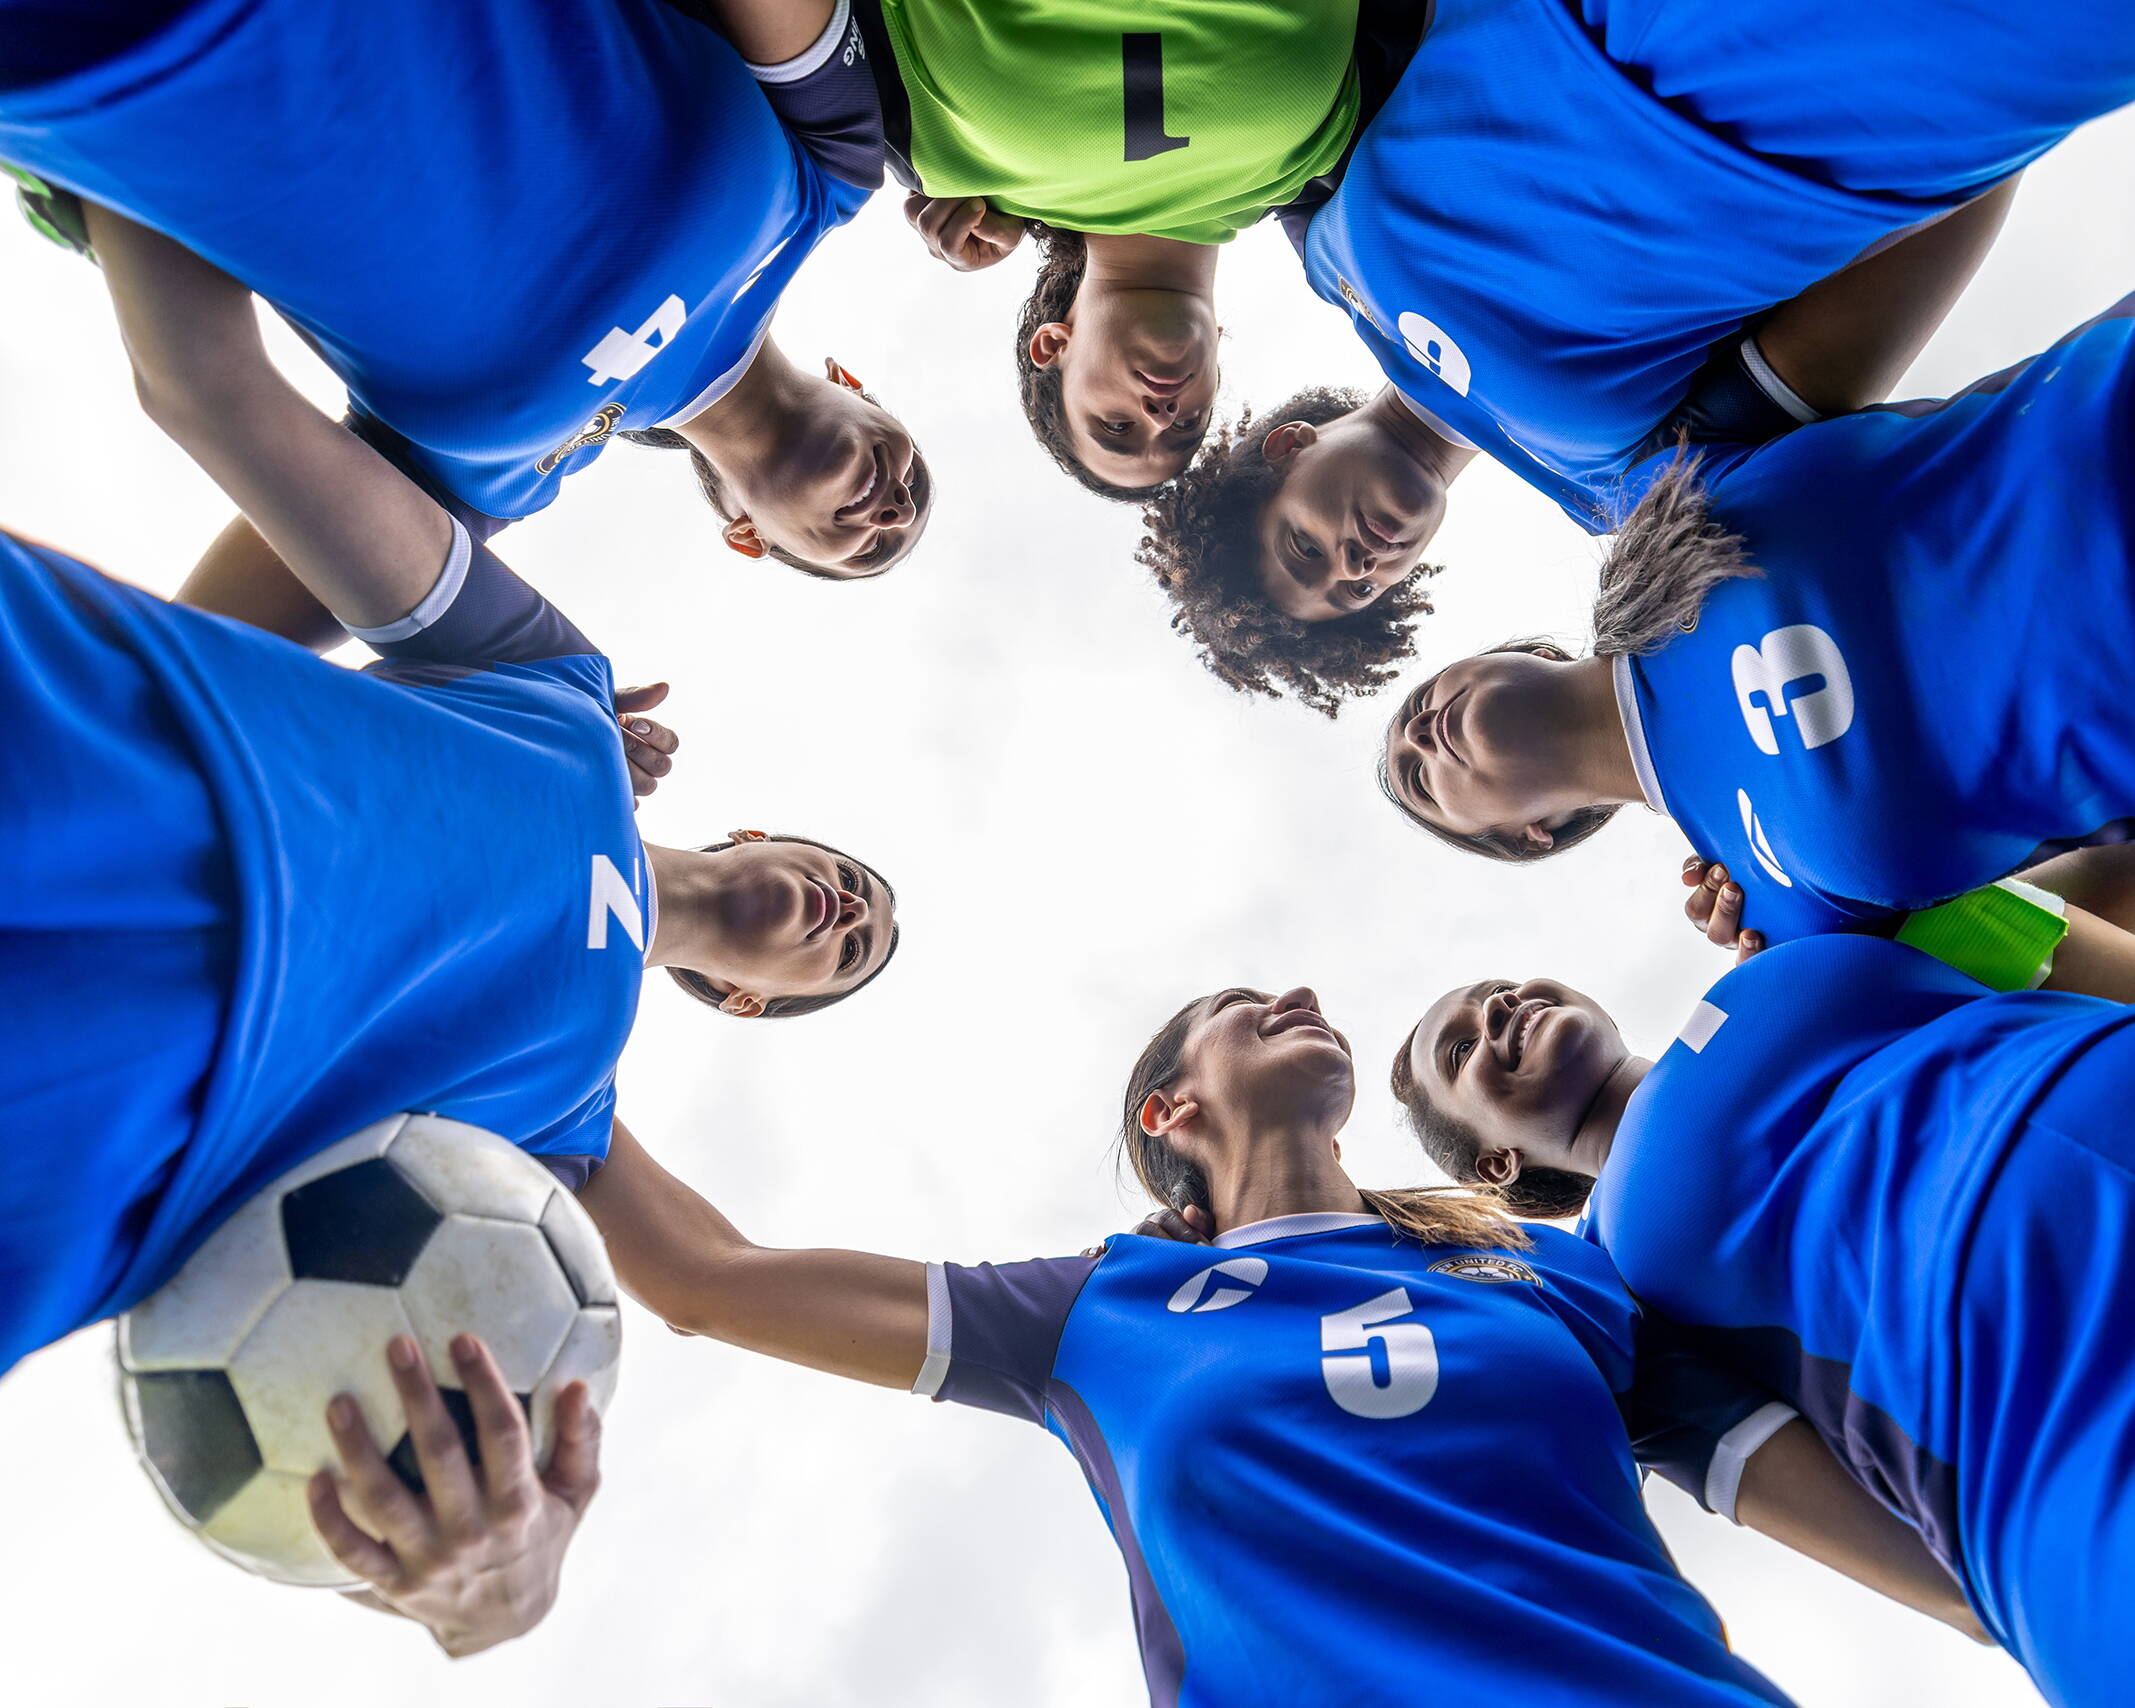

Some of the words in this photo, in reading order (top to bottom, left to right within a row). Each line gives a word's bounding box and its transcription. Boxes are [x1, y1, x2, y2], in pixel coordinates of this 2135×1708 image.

[1121, 32, 1190, 161] 1
[582, 293, 687, 387] 4
[1731, 624, 1854, 756] 3
[1320, 1287, 1440, 1419] 5
